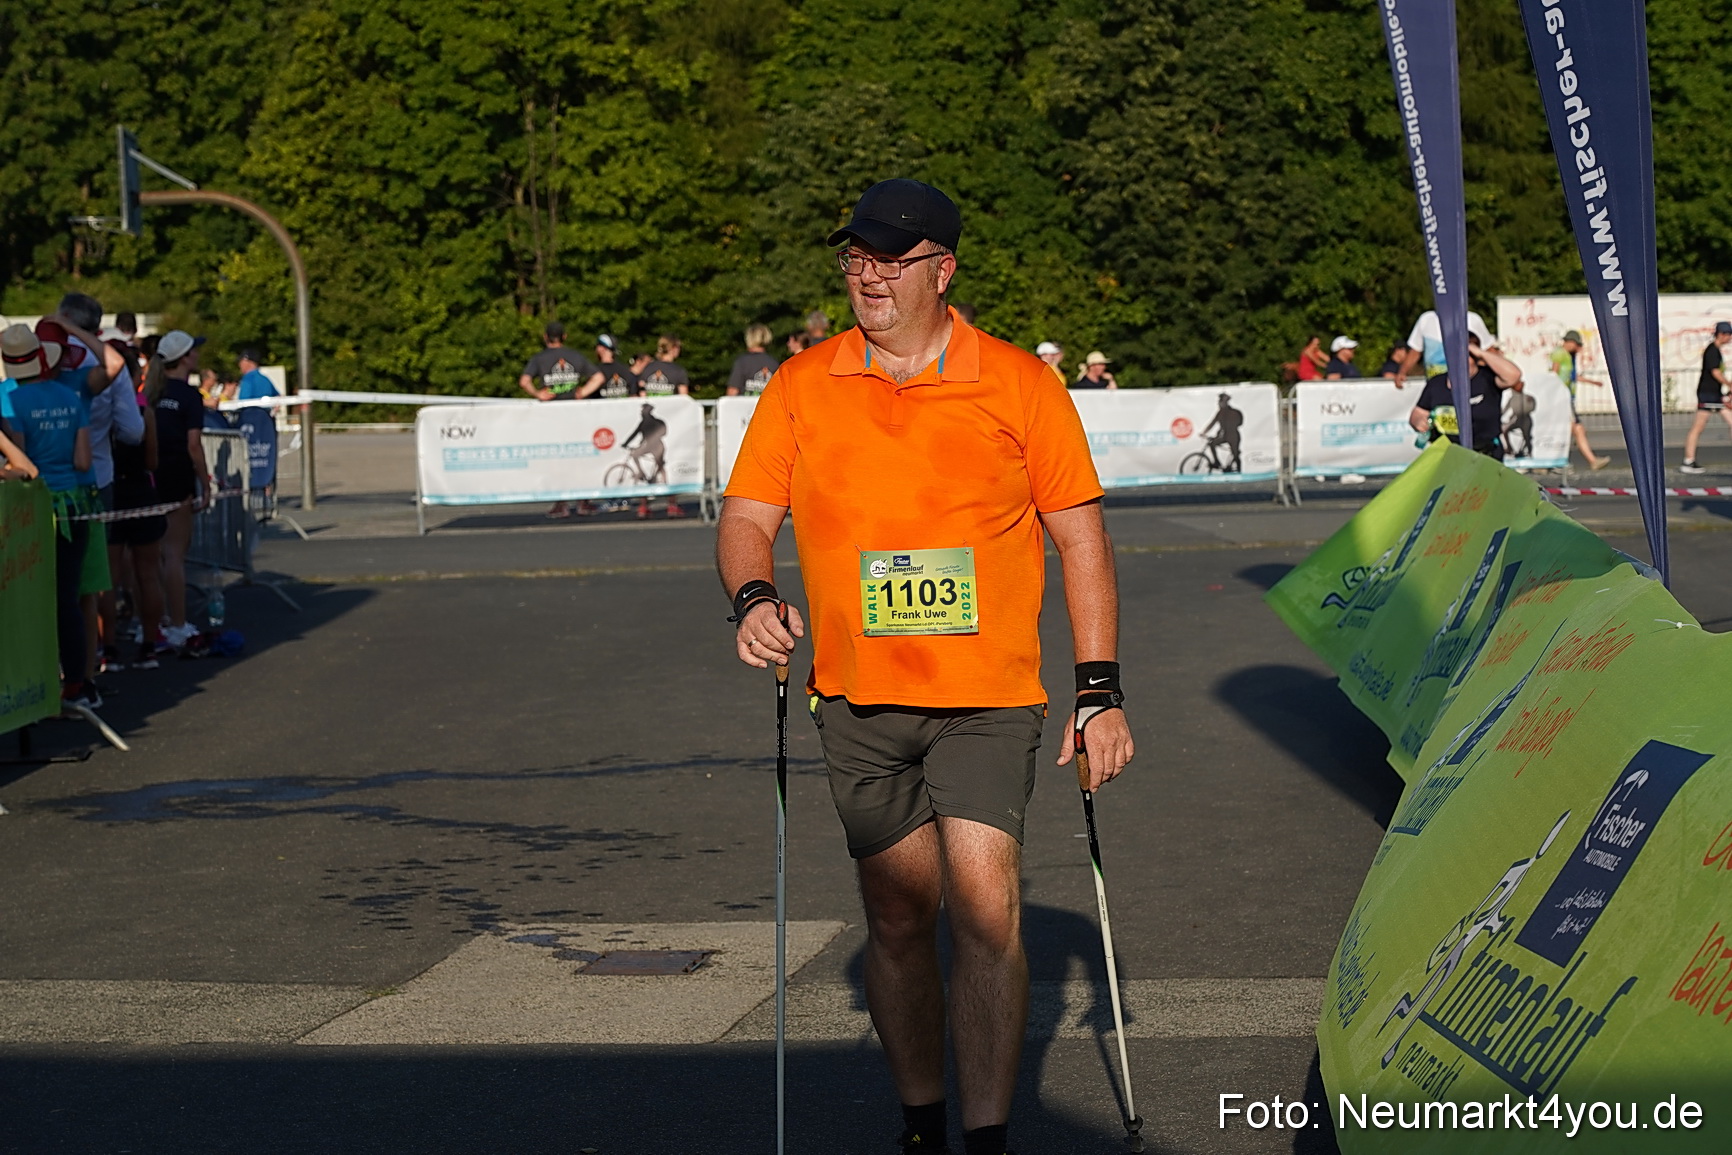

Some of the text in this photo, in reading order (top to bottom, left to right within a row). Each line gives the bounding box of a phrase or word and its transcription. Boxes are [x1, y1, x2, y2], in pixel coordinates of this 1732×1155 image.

[1320, 403, 1356, 416] NOW
[440, 426, 477, 440] NOW
[867, 584, 878, 625] WALK
[880, 578, 957, 607] 1103
[961, 581, 972, 620] 2022
[891, 609, 947, 619] Frank Uwe
[1594, 803, 1646, 848] Fischer
[1583, 848, 1622, 872] AUTOMOBILE
[1668, 921, 1732, 1024] laufe
[1395, 1041, 1466, 1104] neumarkt
